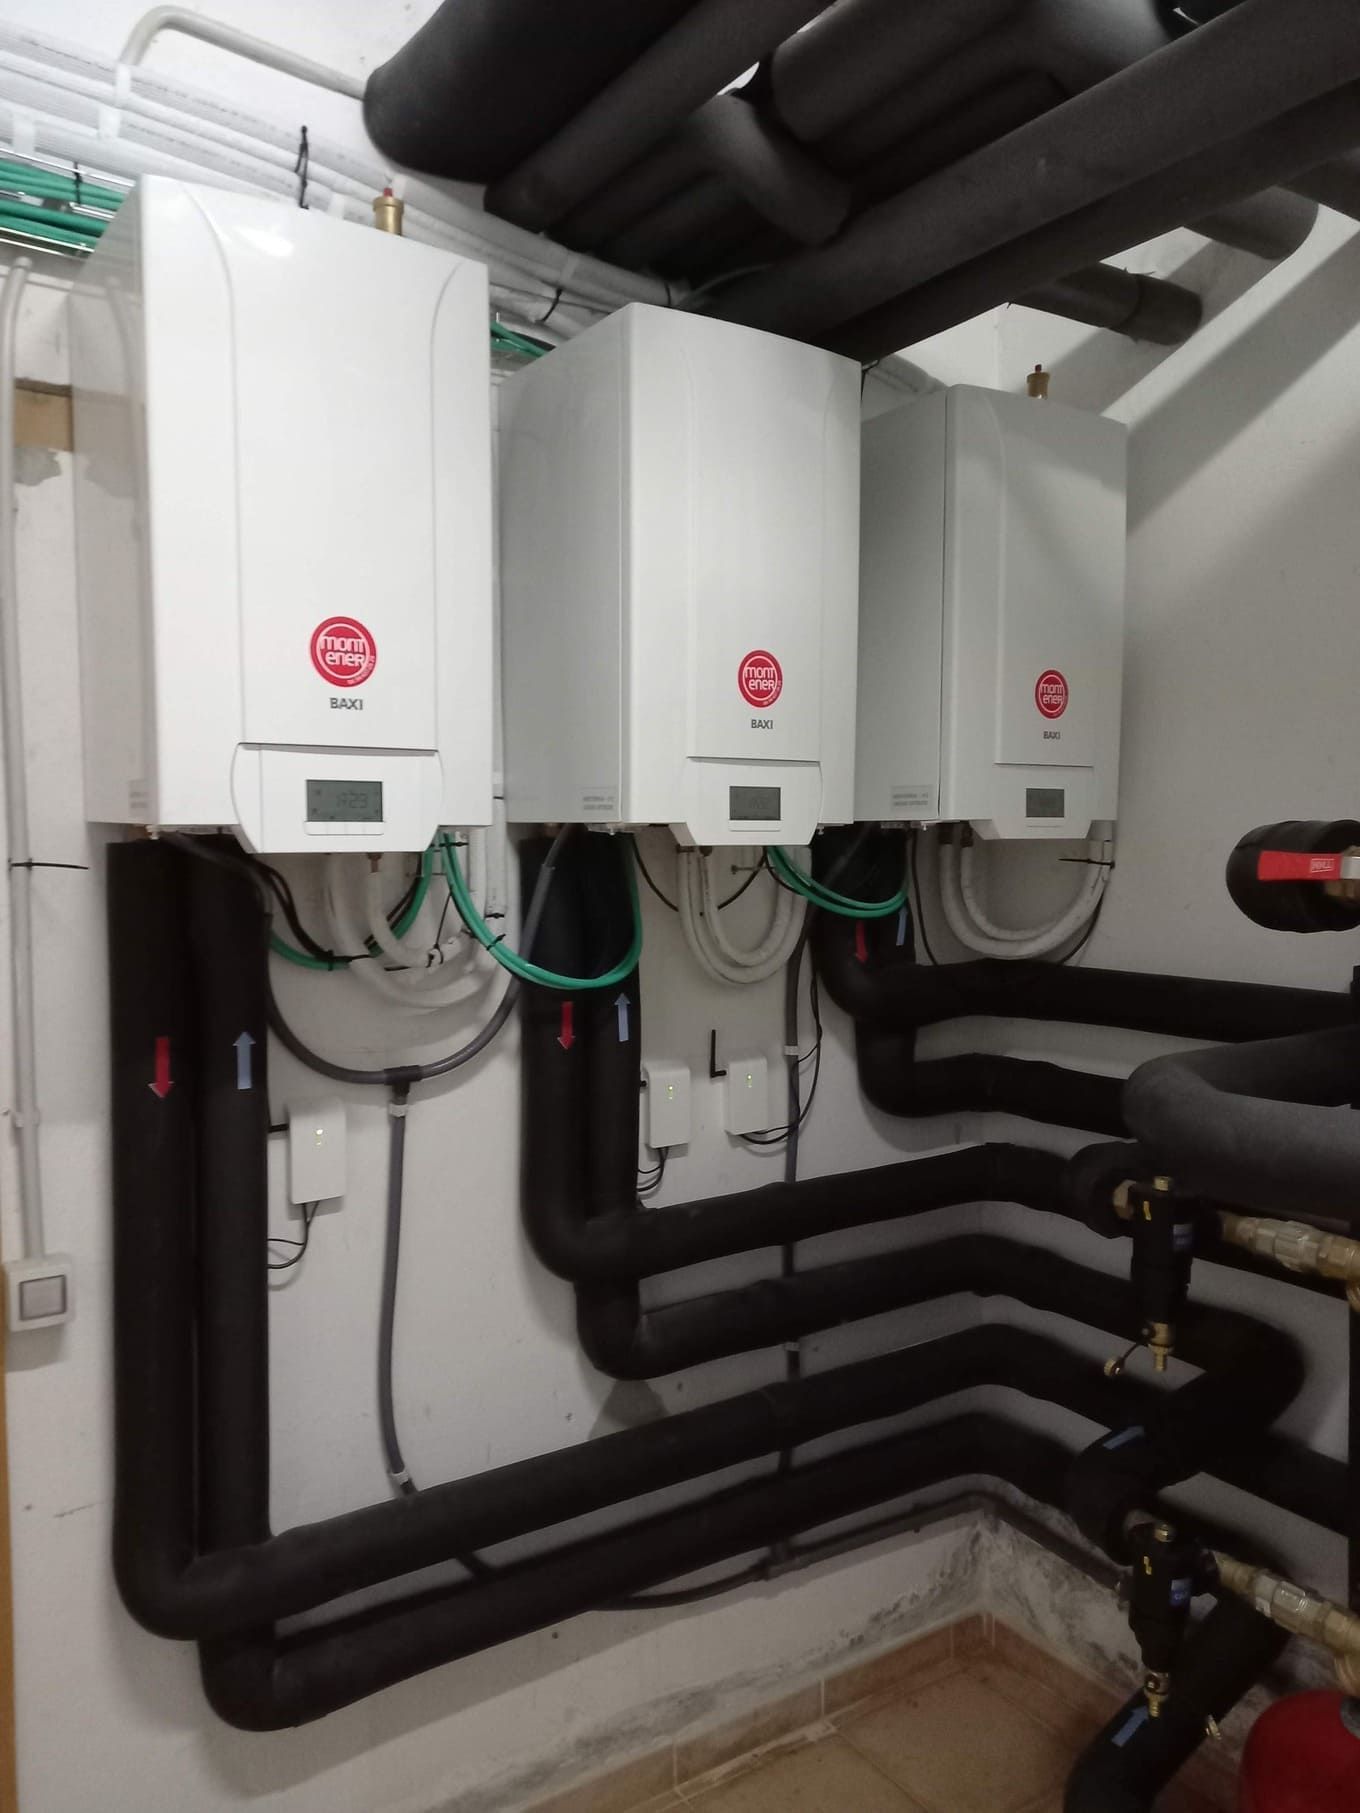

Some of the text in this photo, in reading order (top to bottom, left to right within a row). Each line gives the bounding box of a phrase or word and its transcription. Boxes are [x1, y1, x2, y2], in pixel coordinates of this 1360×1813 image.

[329, 697, 363, 710] BAXI
[751, 719, 773, 729] BAXI
[1043, 731, 1061, 740] BAXI
